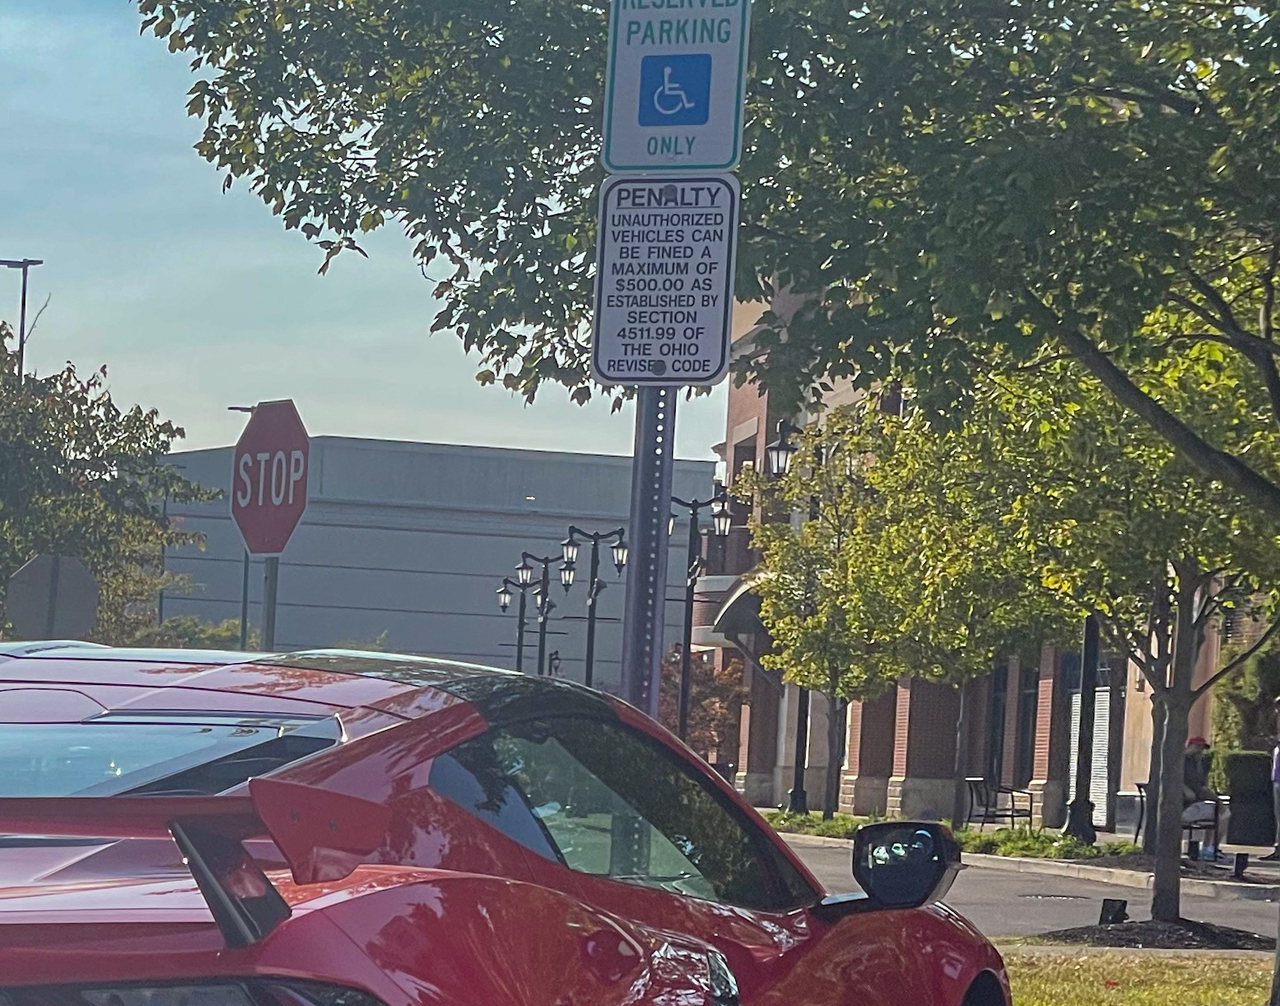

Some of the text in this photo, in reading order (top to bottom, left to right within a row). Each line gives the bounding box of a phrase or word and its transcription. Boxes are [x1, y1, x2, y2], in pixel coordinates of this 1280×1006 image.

[626, 18, 731, 45] PARKING
[647, 136, 696, 155] ONLY
[611, 213, 724, 227] UNAUTHORIZED
[611, 229, 723, 243] VEHICLES CAN
[620, 246, 712, 259] BE FINED A
[611, 262, 719, 275] MAXIMUM OF
[615, 278, 712, 292] $500.00 AS
[606, 294, 719, 308] ESTABLISHED BY
[627, 311, 697, 324] SECTION
[616, 327, 705, 340] 4511.99 OF
[621, 343, 699, 356] THE OHIO
[607, 359, 711, 373] REVISE CODE
[237, 450, 305, 508] STOP
